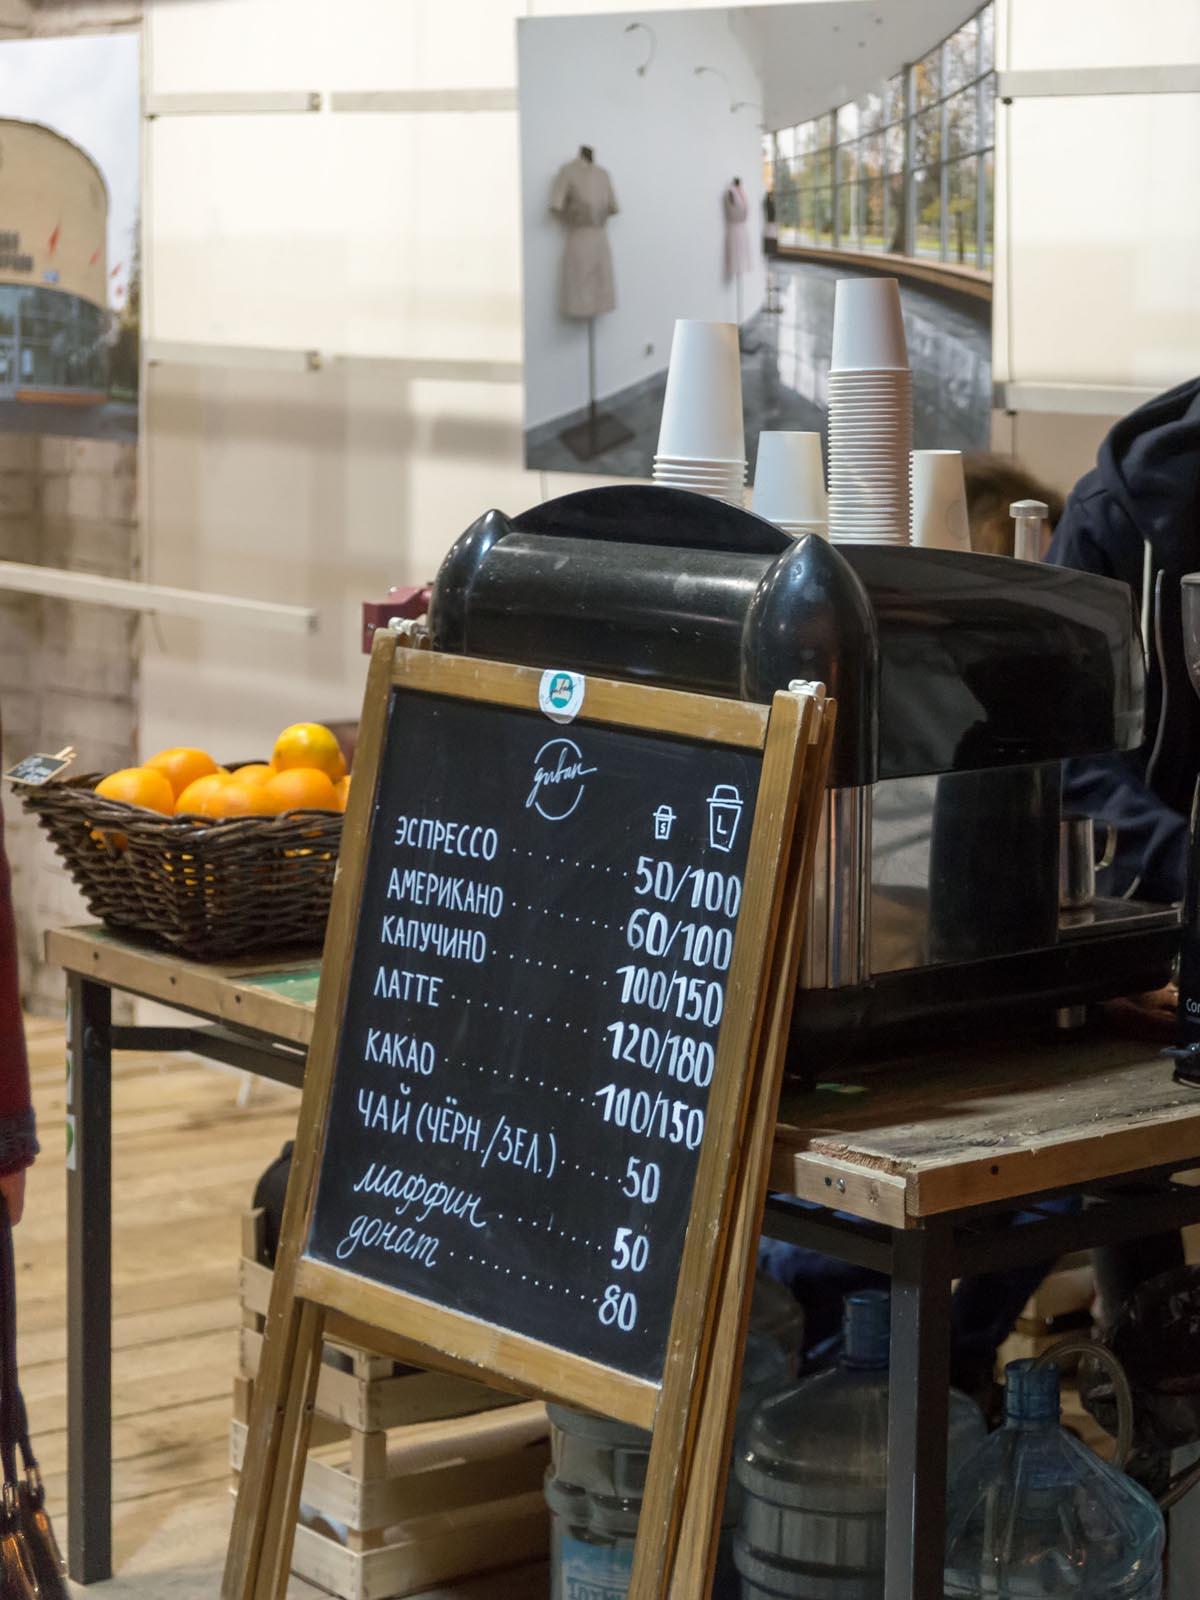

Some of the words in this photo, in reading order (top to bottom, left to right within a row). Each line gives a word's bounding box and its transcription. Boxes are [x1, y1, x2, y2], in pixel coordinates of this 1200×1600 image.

[394, 815, 498, 861] ЭСПРЕССО
[633, 855, 741, 918] 50/100
[659, 821, 668, 835] S
[716, 814, 728, 835] L
[380, 915, 487, 964] КАПУЧИНО
[615, 964, 723, 1028] 100/150
[386, 867, 504, 918] АМЕРИКАНО
[626, 907, 732, 970] 60/100
[373, 965, 444, 1008] ЛАТТЕ
[606, 1020, 715, 1087] 120/180
[358, 1082, 411, 1135] ЧАЙ
[622, 1155, 661, 1204] 50
[364, 1027, 435, 1076] КАКАО
[594, 1083, 704, 1150] 100/150
[336, 1215, 440, 1268] донат
[598, 1285, 638, 1332] 80
[353, 1162, 487, 1228] маффин
[610, 1226, 650, 1272] 50
